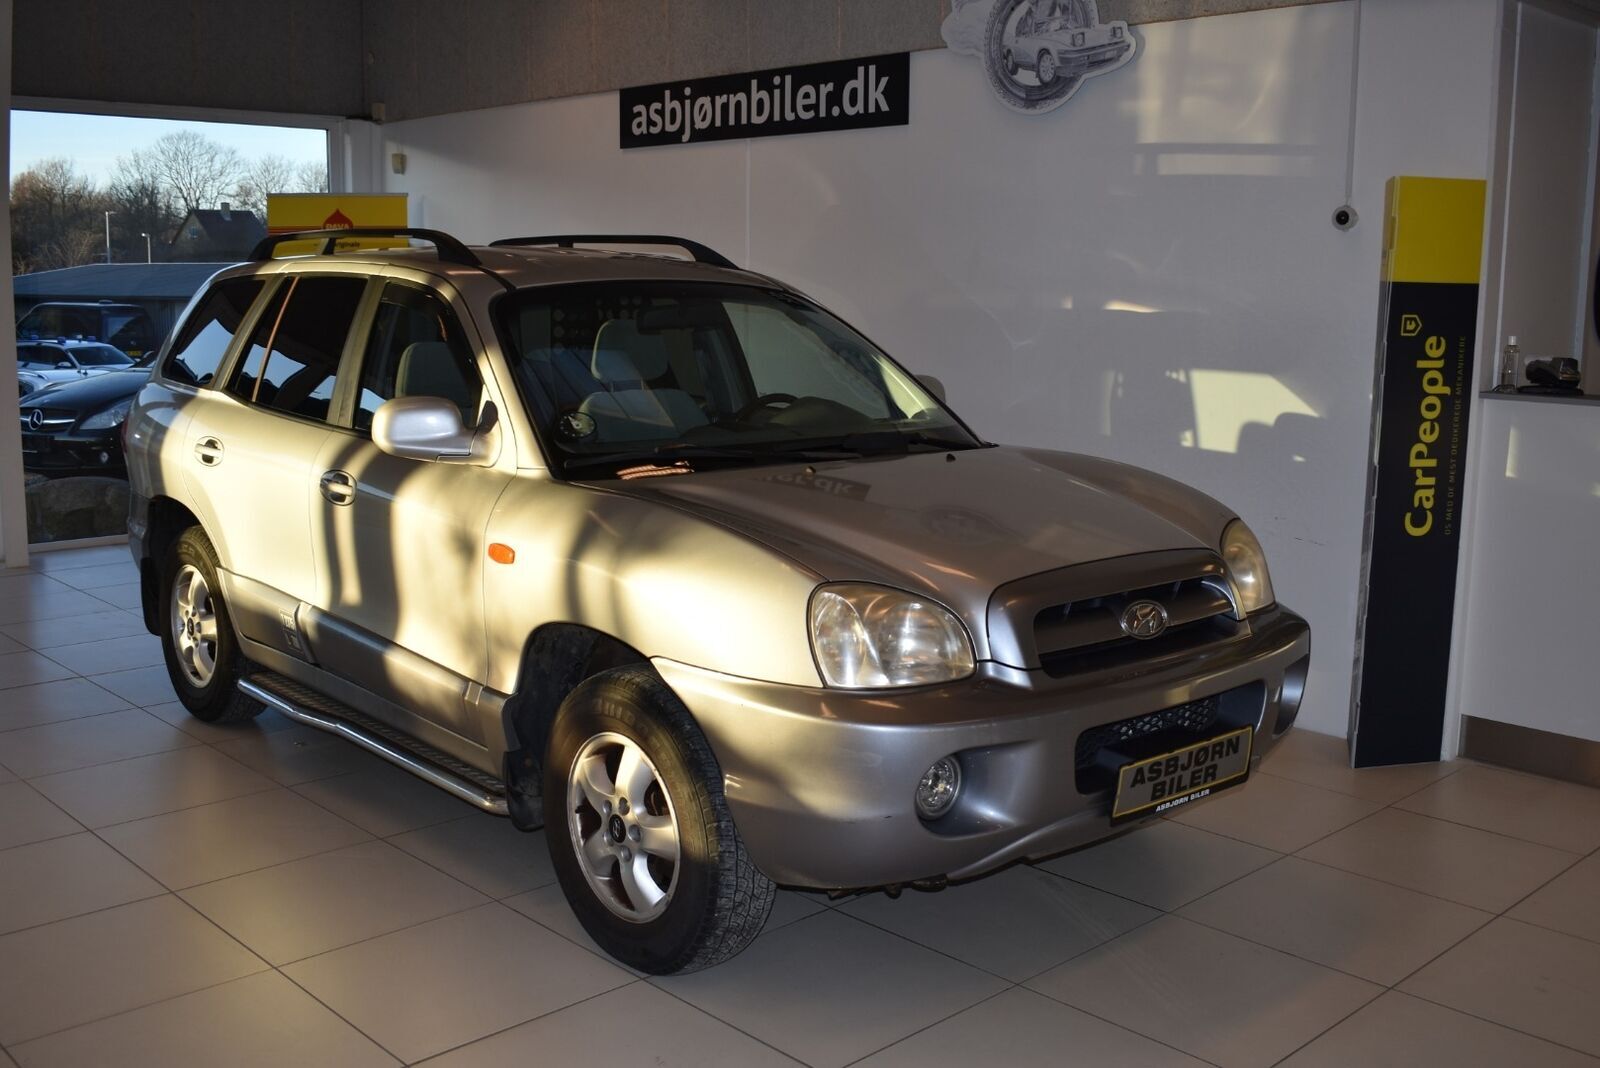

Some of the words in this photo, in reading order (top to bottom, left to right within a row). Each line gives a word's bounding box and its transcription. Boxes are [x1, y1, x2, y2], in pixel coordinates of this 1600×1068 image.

[631, 64, 890, 143] asbjørnbiler.dk
[1404, 335, 1451, 537] CarPeople
[1449, 458, 1457, 483] MEST
[1447, 487, 1455, 498] DE
[1446, 500, 1454, 521] MED
[1130, 736, 1240, 788] ASBJØRN
[1150, 763, 1219, 801] BILER
[1155, 796, 1189, 813] ASBJØRN
[1190, 788, 1210, 801] BILER
